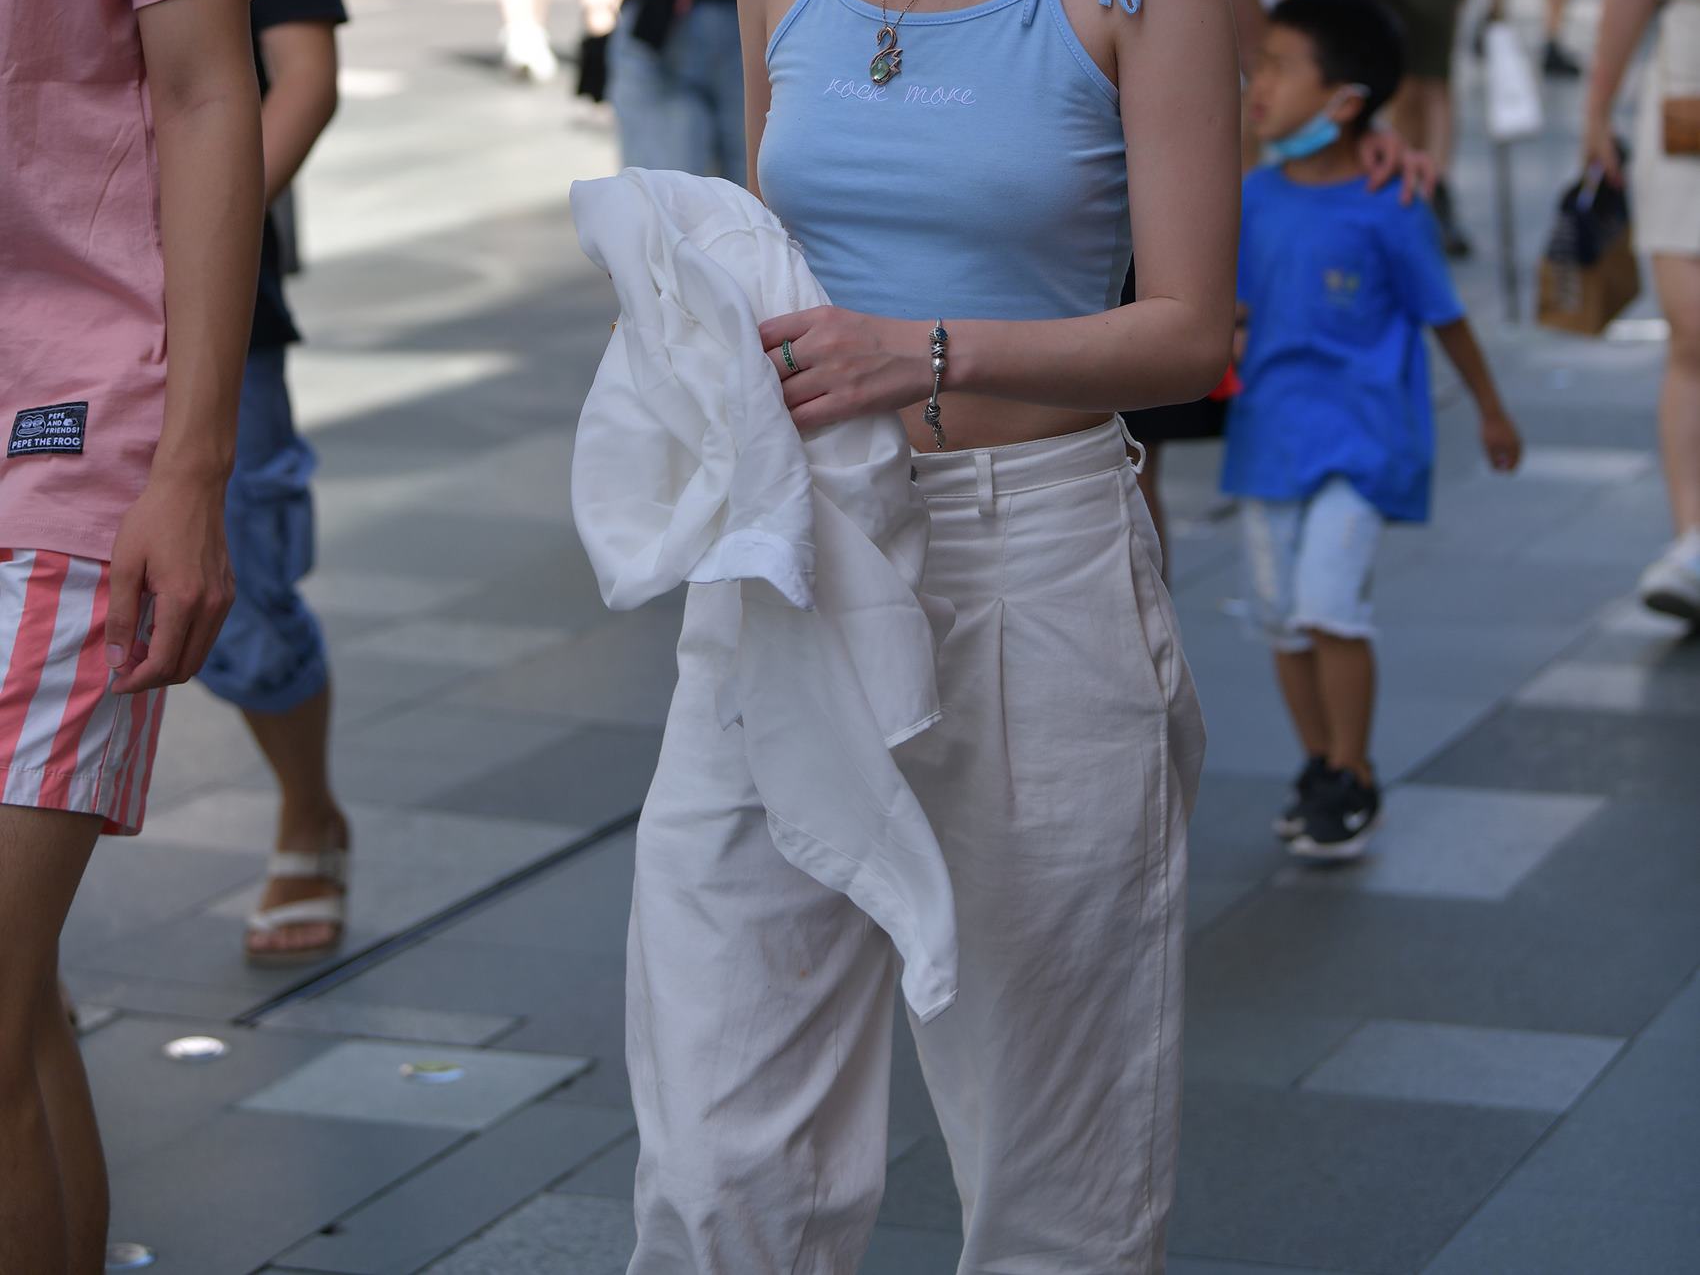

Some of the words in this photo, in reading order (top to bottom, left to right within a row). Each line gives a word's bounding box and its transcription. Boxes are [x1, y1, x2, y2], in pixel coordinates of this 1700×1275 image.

[904, 84, 977, 105] more
[12, 439, 32, 449] PEPE
[35, 438, 52, 446] THE
[53, 437, 80, 445] FROG
